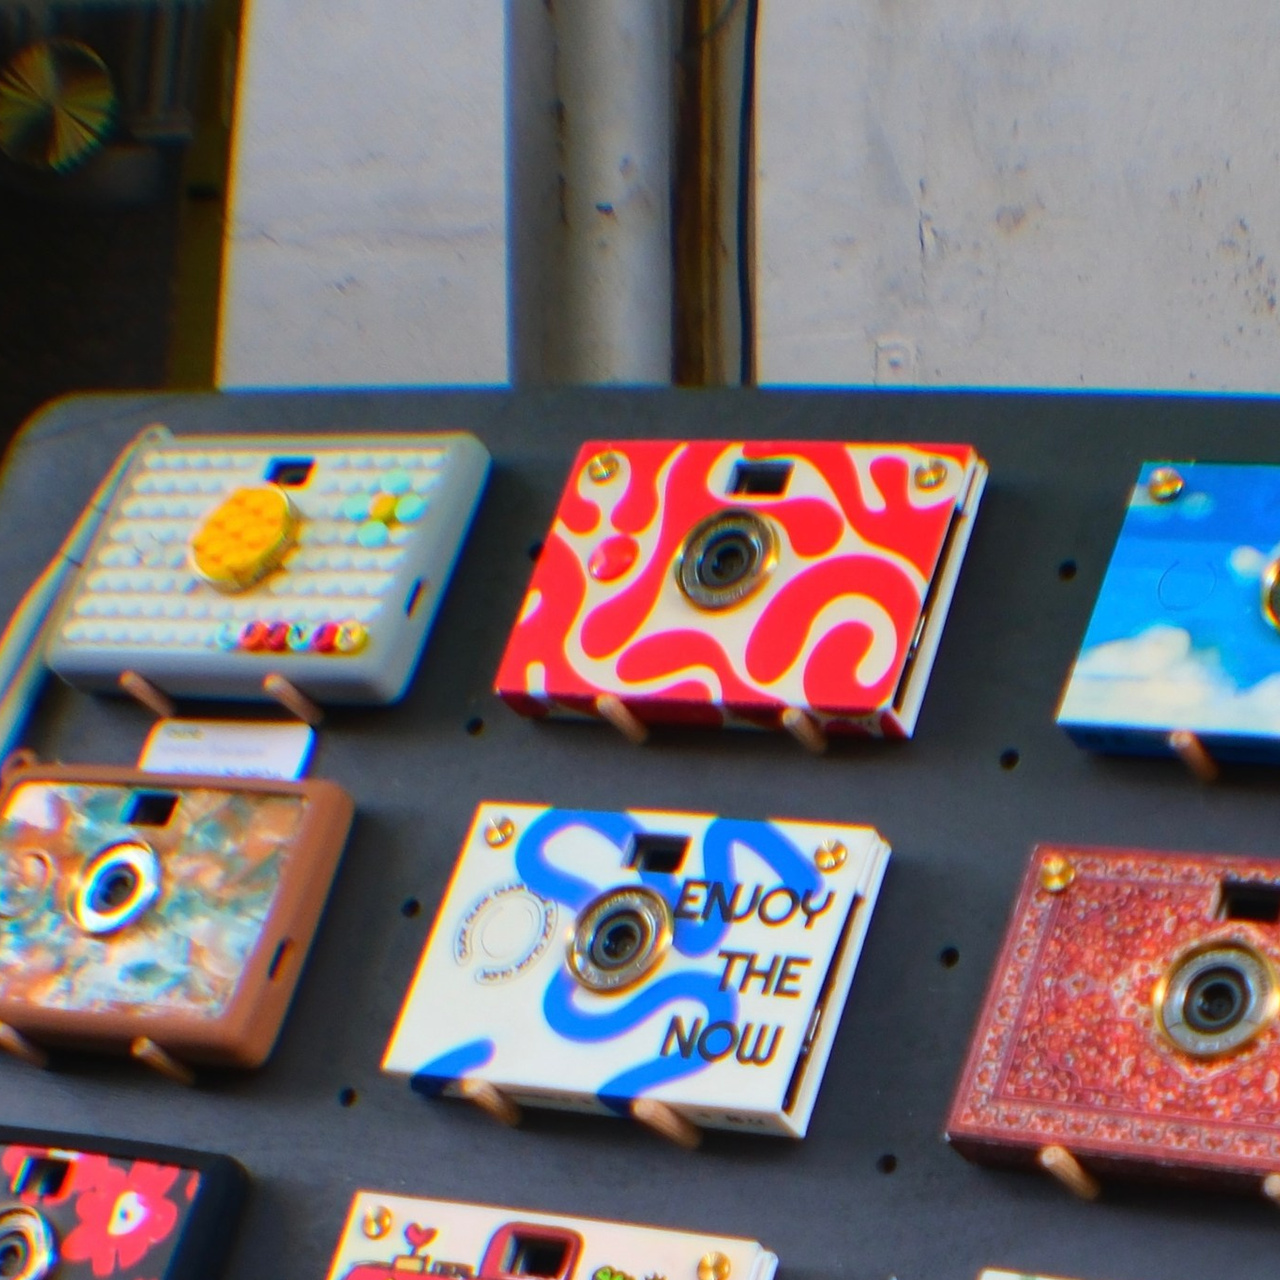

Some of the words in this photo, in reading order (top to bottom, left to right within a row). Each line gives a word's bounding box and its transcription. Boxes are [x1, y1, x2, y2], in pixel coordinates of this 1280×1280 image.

[674, 879, 836, 930] ENJOY
[718, 950, 812, 999] THE
[660, 1015, 784, 1067] NOW
